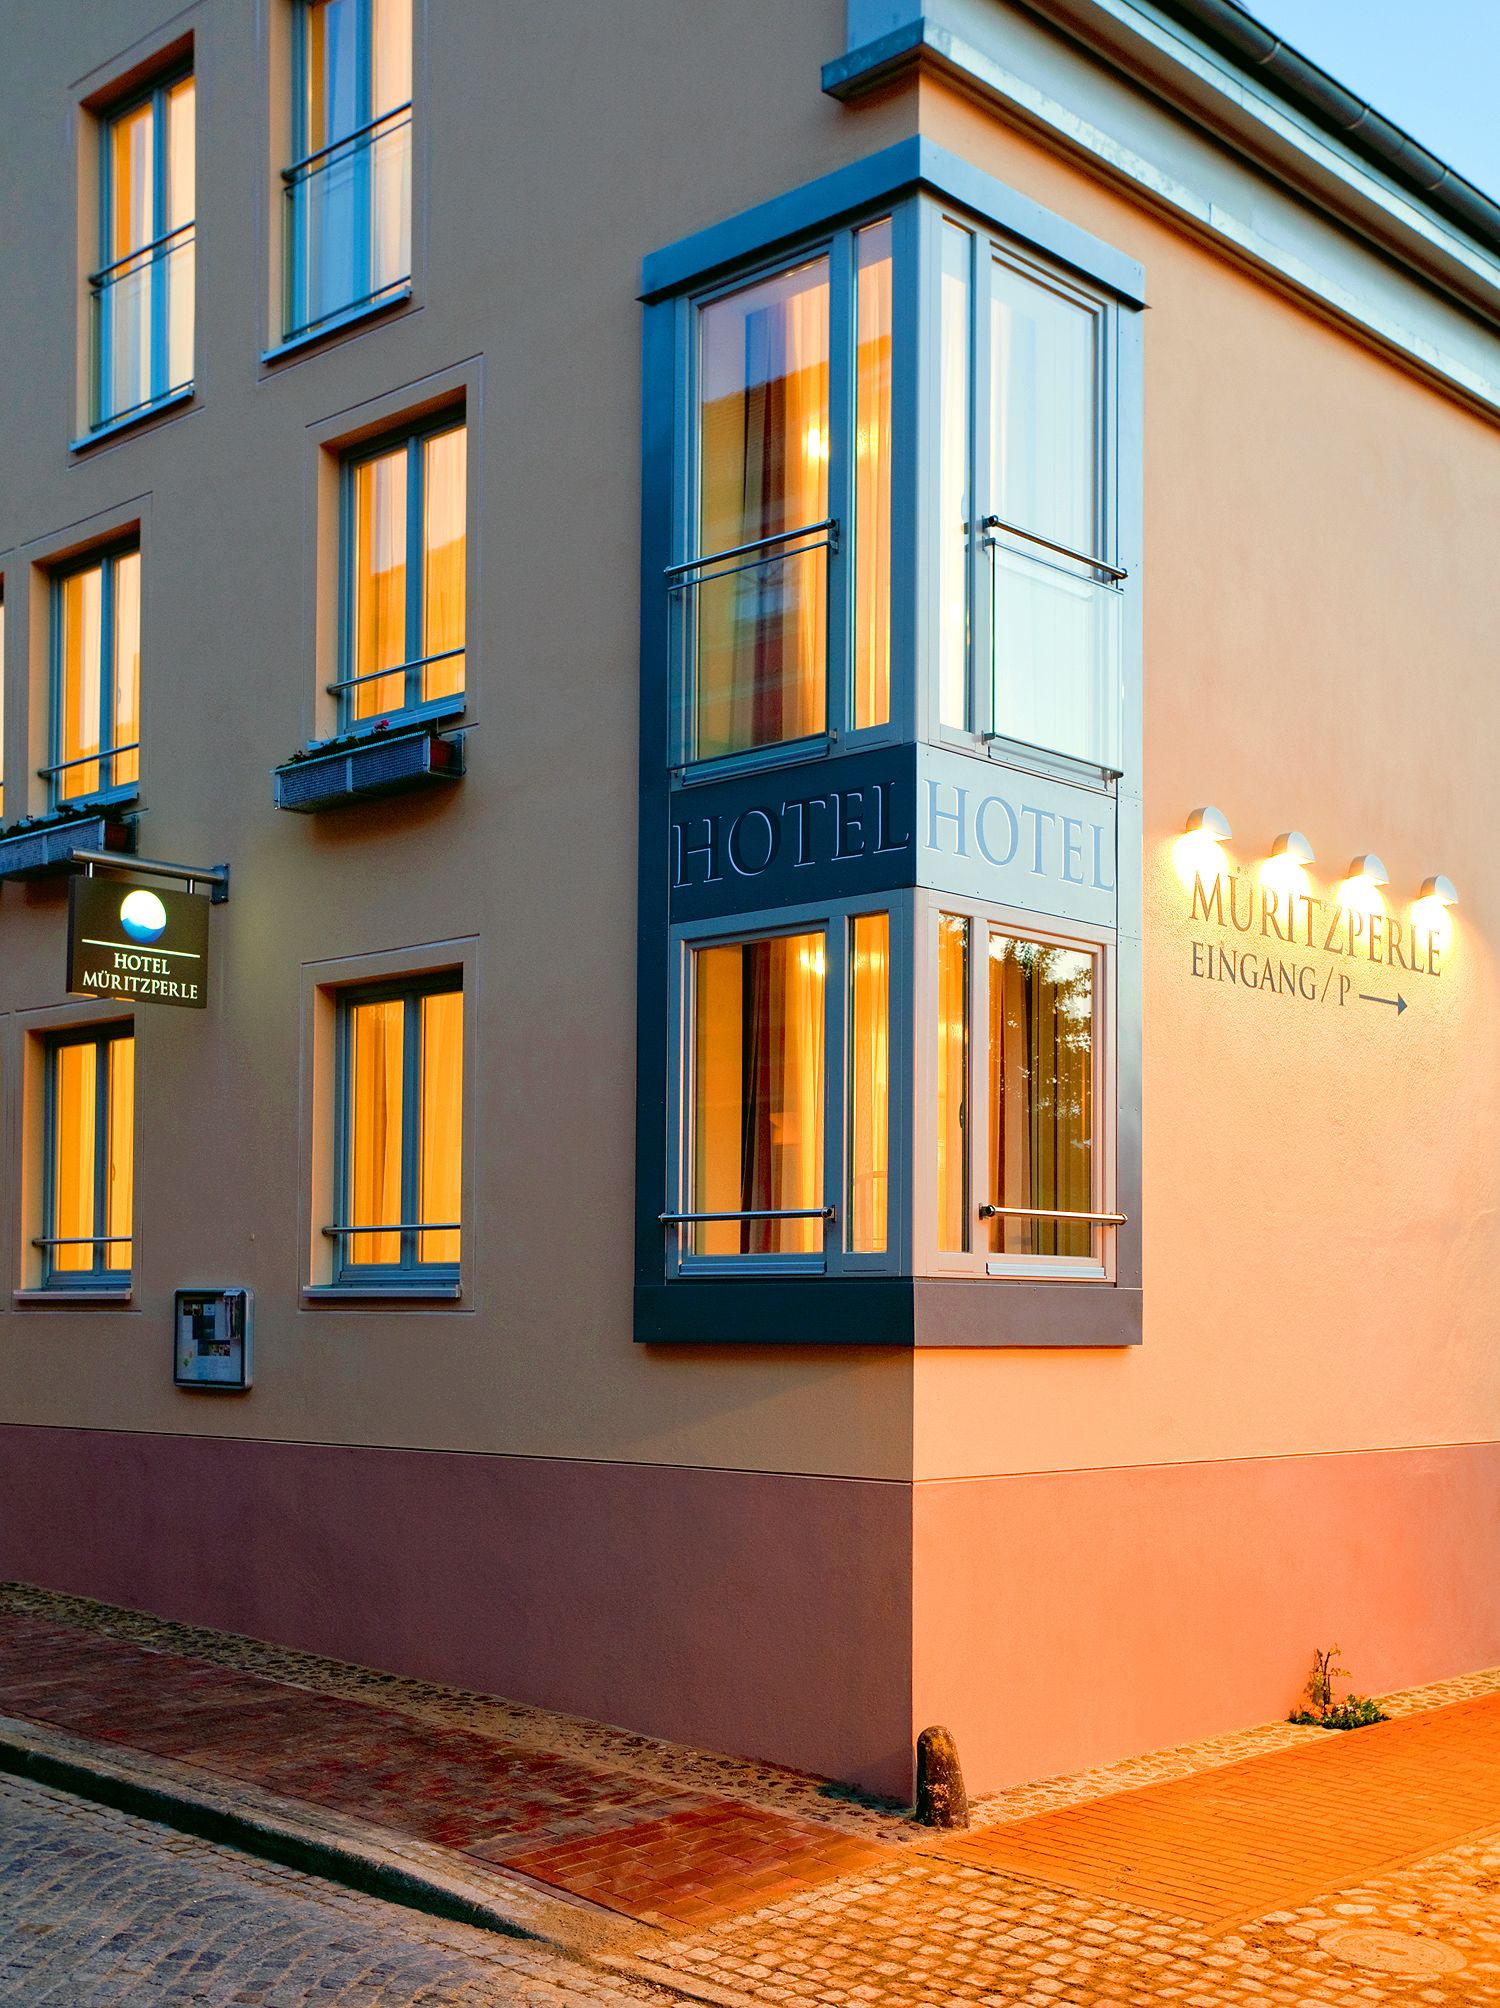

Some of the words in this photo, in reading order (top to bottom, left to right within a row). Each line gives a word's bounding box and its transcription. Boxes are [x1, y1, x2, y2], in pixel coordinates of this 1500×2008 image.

[673, 781, 909, 888] HOTEL
[923, 779, 1115, 892] HOTEL
[114, 953, 170, 975] HOTEL
[1189, 866, 1441, 977] MÜRITZPERLE
[82, 970, 198, 1000] MÜRITZPERLE
